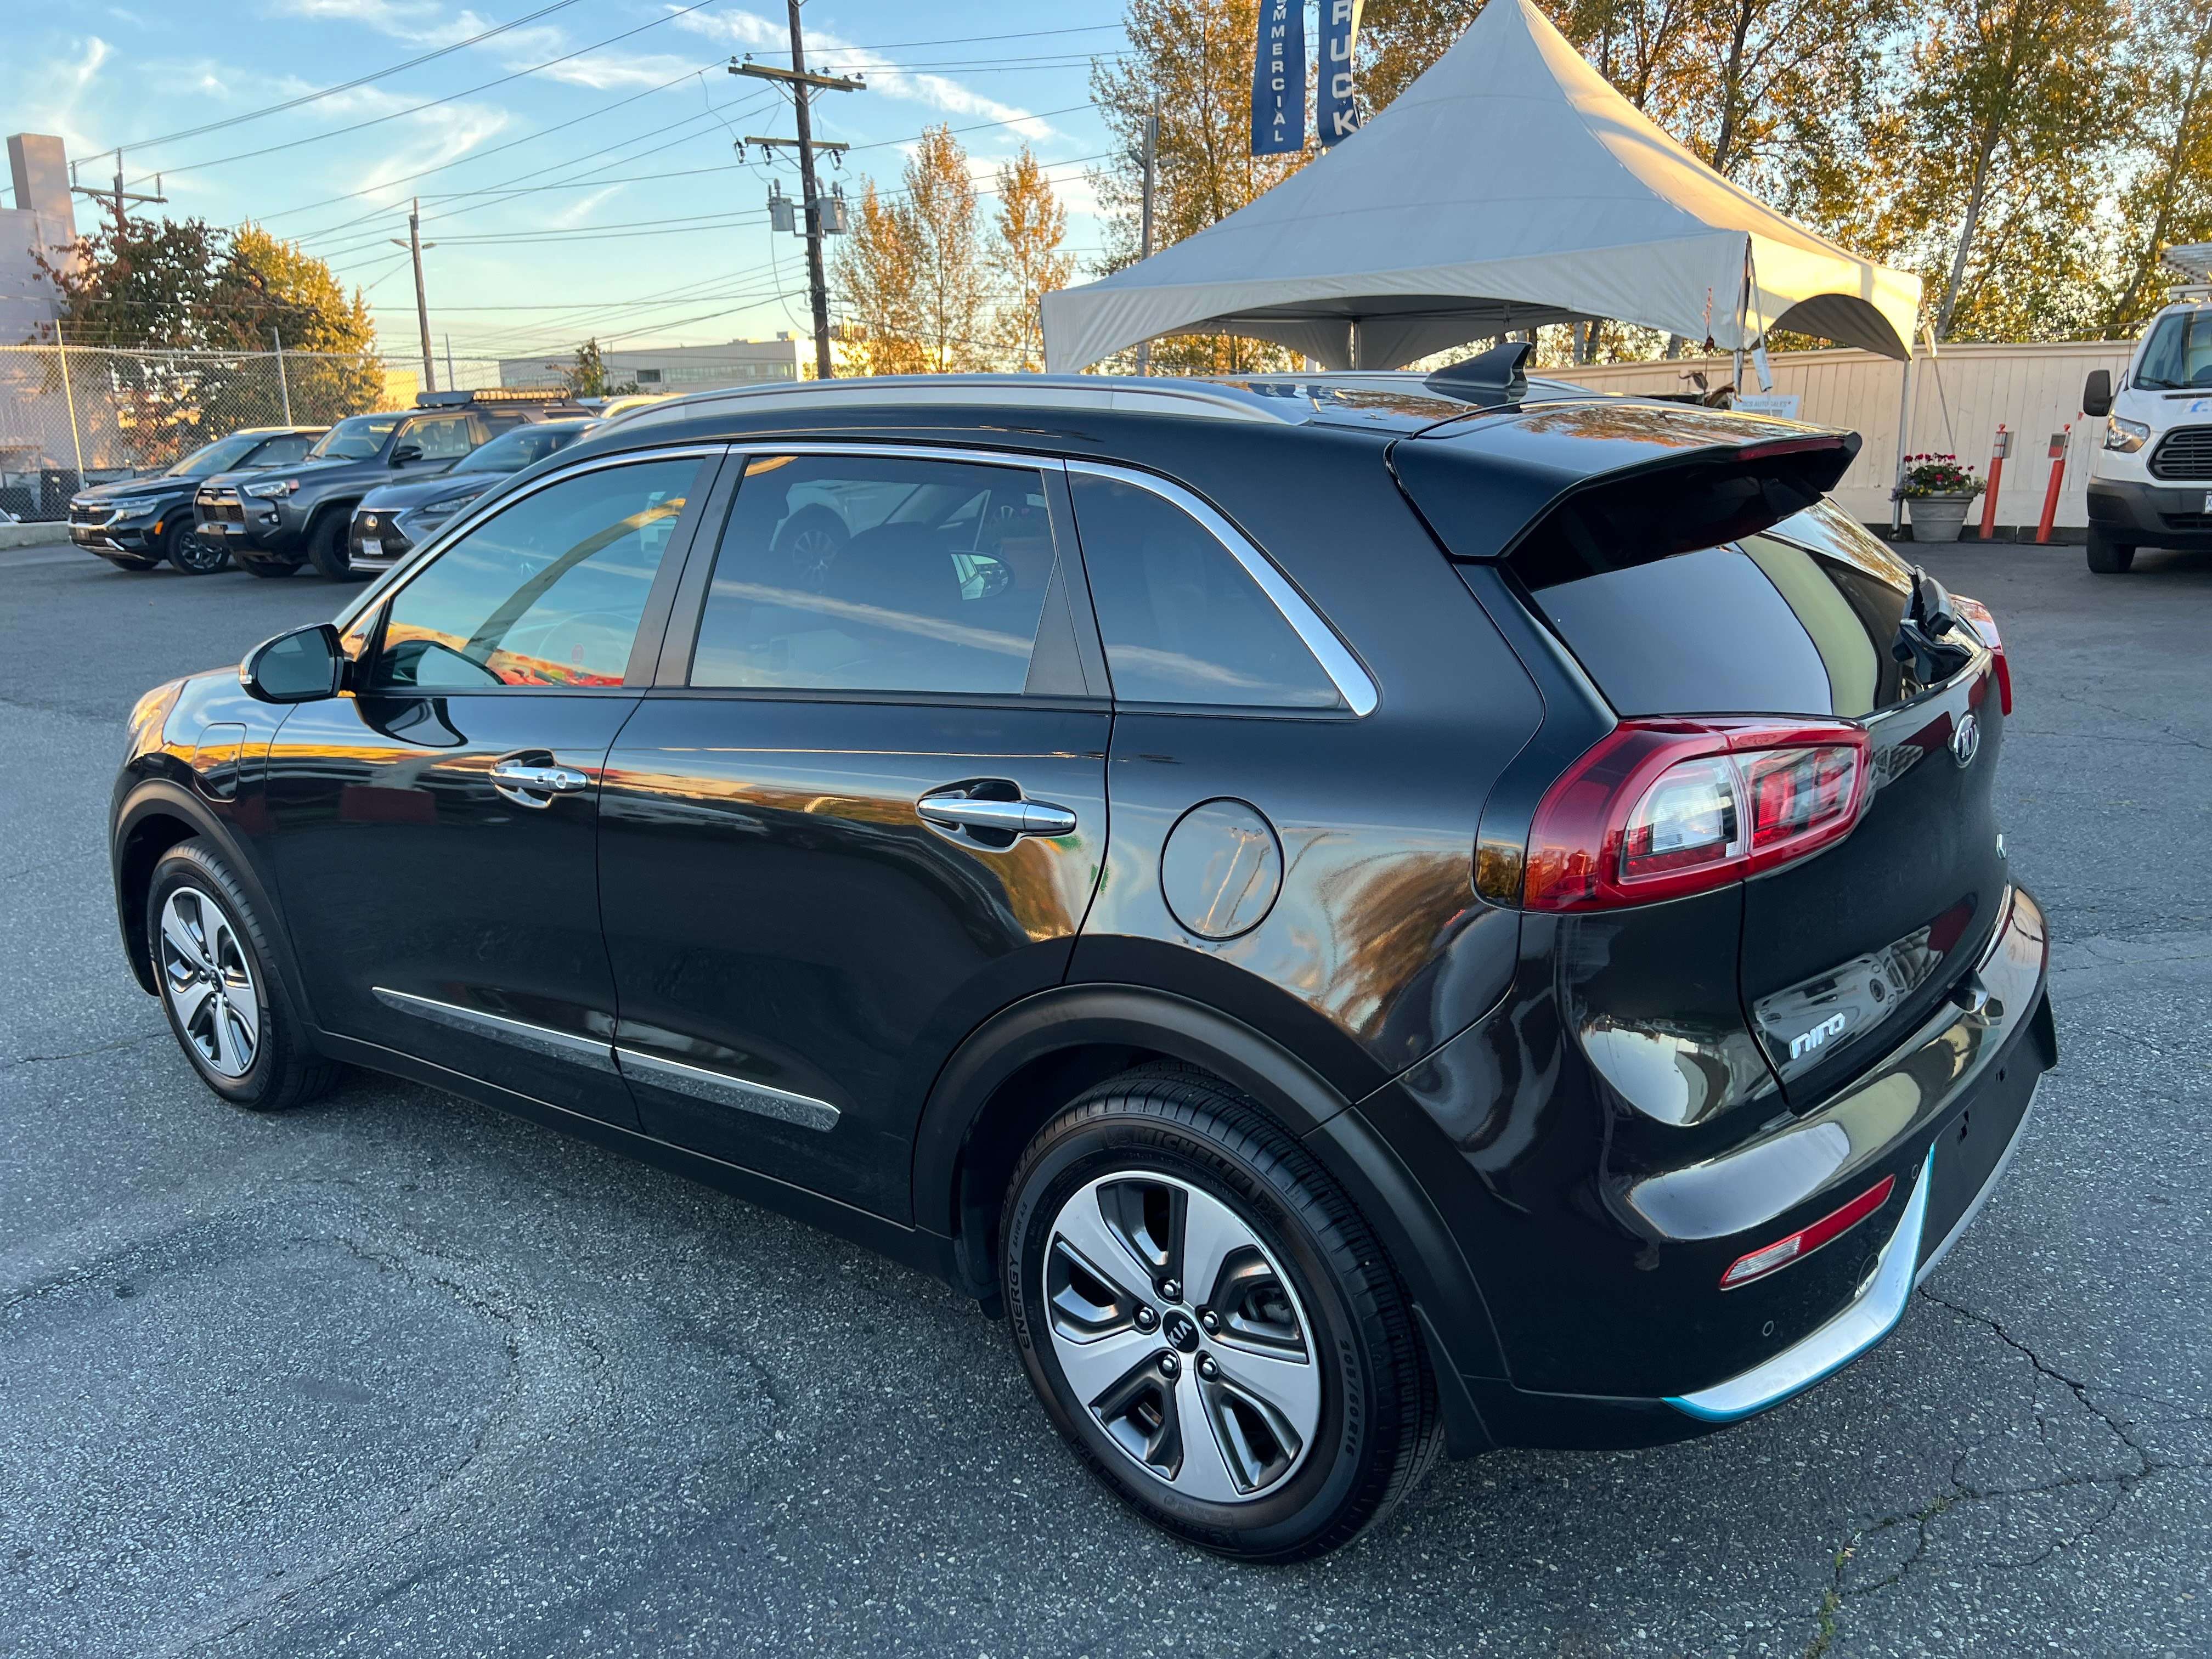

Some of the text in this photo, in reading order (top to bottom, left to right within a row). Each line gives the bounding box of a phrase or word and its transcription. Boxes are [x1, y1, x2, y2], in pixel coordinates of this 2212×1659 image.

[1330, 1, 1357, 136] RUCK
[1135, 1126, 1255, 1200] MICHELIN
[1013, 1218, 1022, 1248] SAVER
[1009, 1253, 1029, 1350] ENERGY
[1167, 1320, 1193, 1348] KIA
